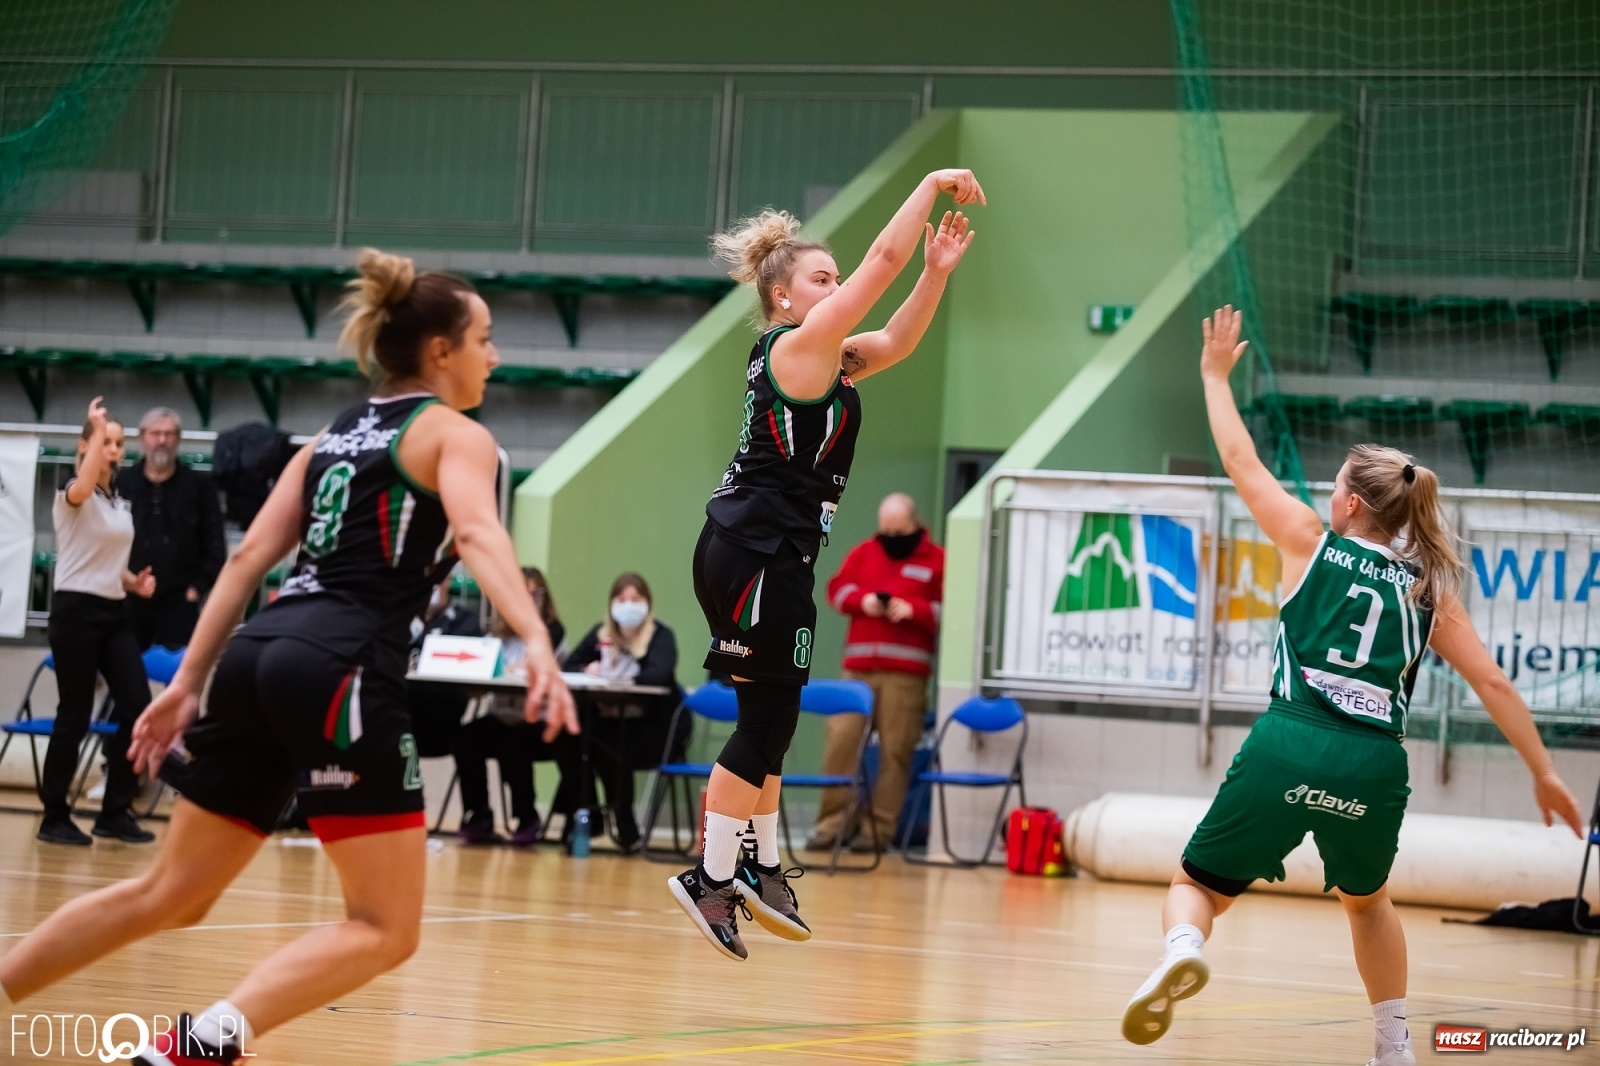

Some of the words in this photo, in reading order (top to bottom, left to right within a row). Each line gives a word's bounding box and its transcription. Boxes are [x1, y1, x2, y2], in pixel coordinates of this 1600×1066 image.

[1322, 546, 1357, 571] RKK
[1326, 583, 1384, 669] 3
[720, 639, 749, 658] Haldex
[794, 628, 812, 669] 8
[1304, 789, 1368, 816] Clavis
